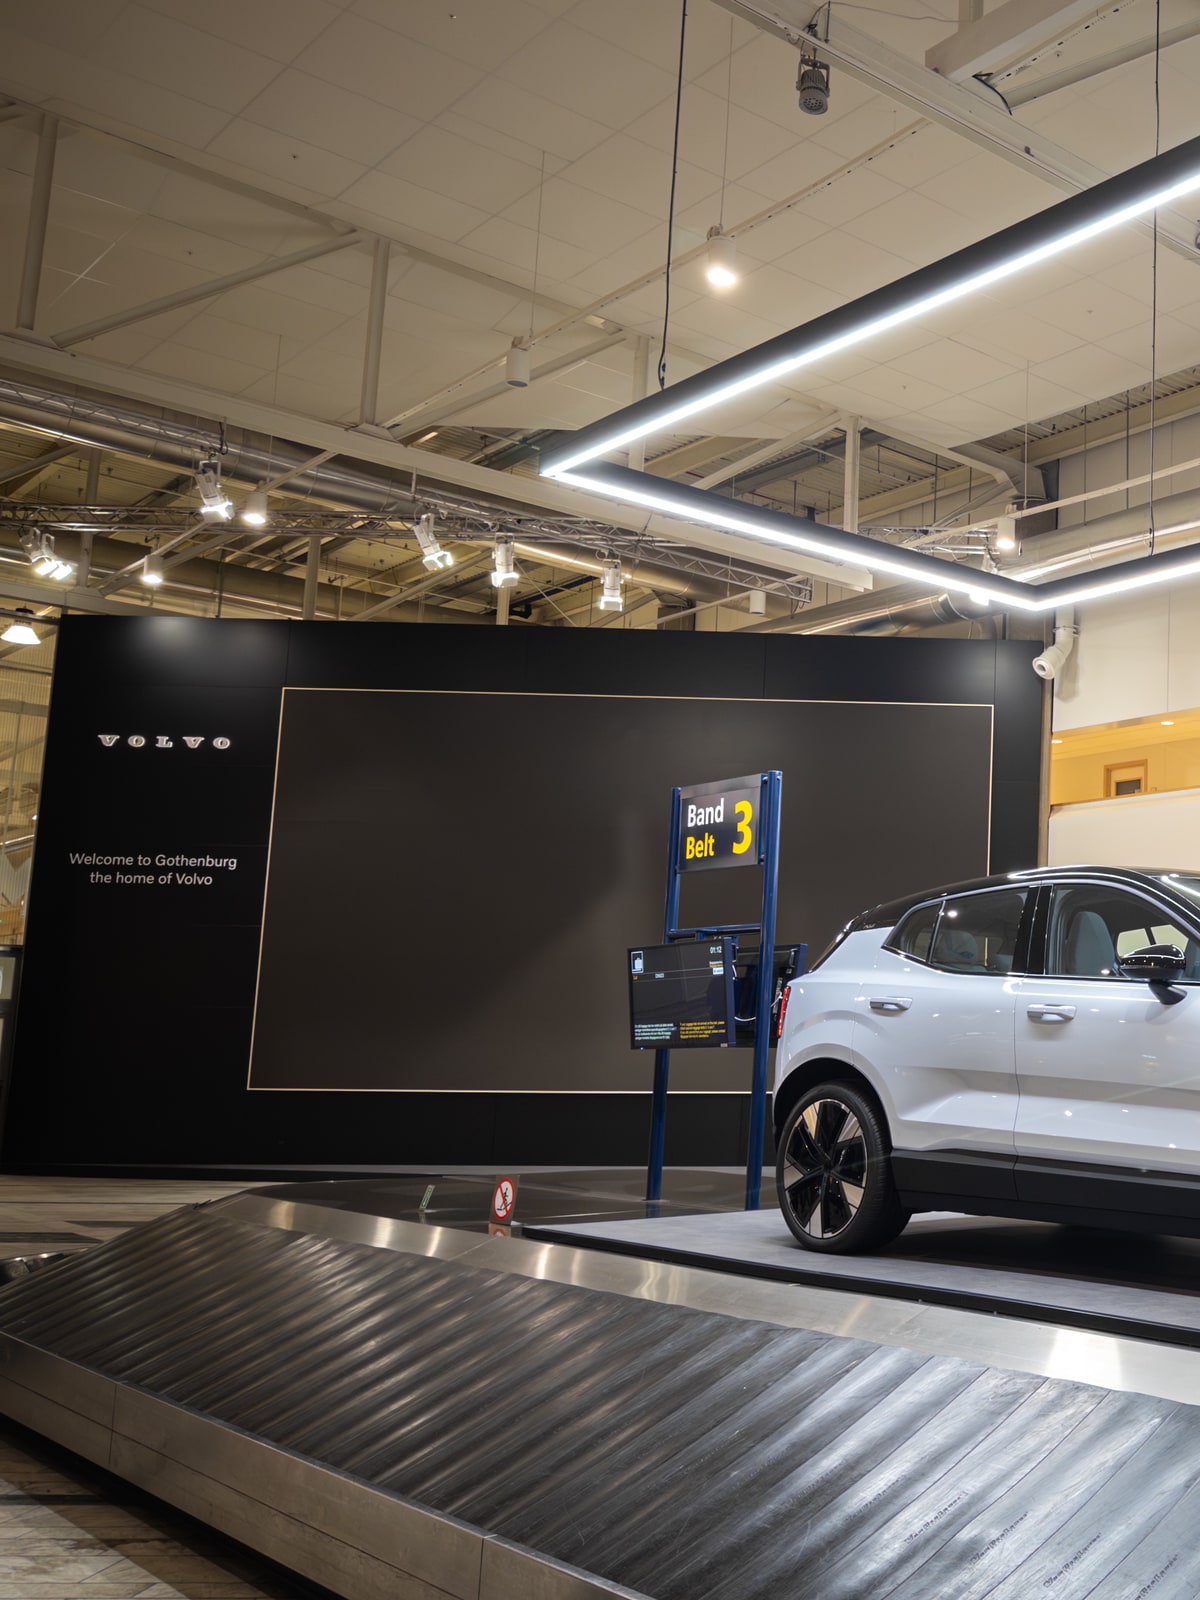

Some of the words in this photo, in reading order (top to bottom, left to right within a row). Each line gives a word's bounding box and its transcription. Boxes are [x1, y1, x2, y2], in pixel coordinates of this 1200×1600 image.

[97, 734, 231, 750] VOLVO
[687, 797, 725, 828] Band
[732, 800, 753, 854] 3
[685, 832, 715, 860] Belt
[69, 853, 134, 865] Welcome
[138, 854, 151, 866] to
[155, 854, 238, 871] Gothenburg
[89, 872, 112, 884] the
[115, 872, 155, 885] home
[158, 873, 174, 885] of
[175, 873, 213, 885] Volvo
